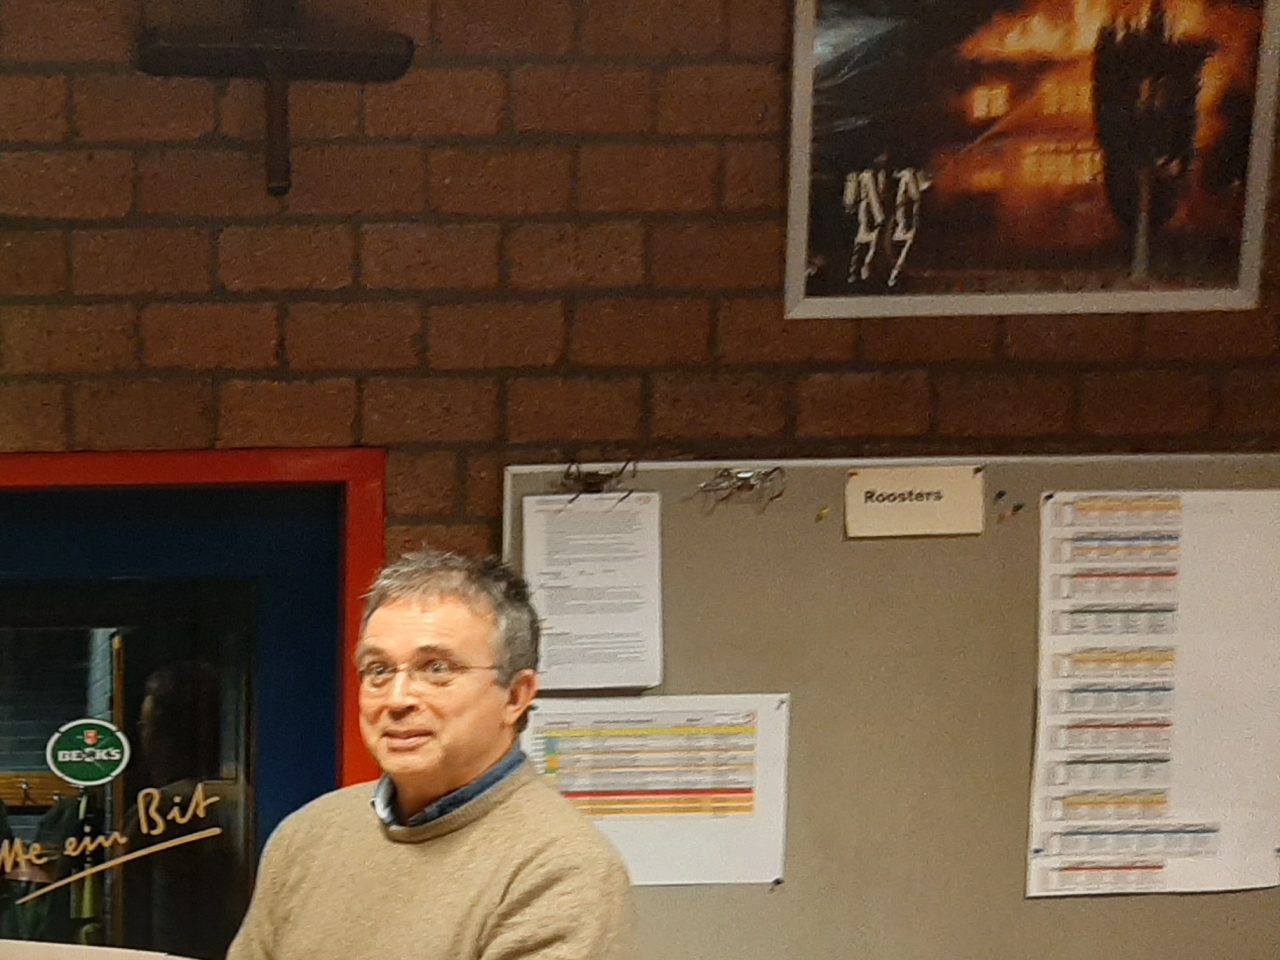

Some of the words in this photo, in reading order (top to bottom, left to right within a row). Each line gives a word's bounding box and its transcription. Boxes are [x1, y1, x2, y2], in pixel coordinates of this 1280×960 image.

[864, 490, 943, 503] Roosters
[63, 825, 128, 856] ein
[137, 783, 220, 836] Bit
